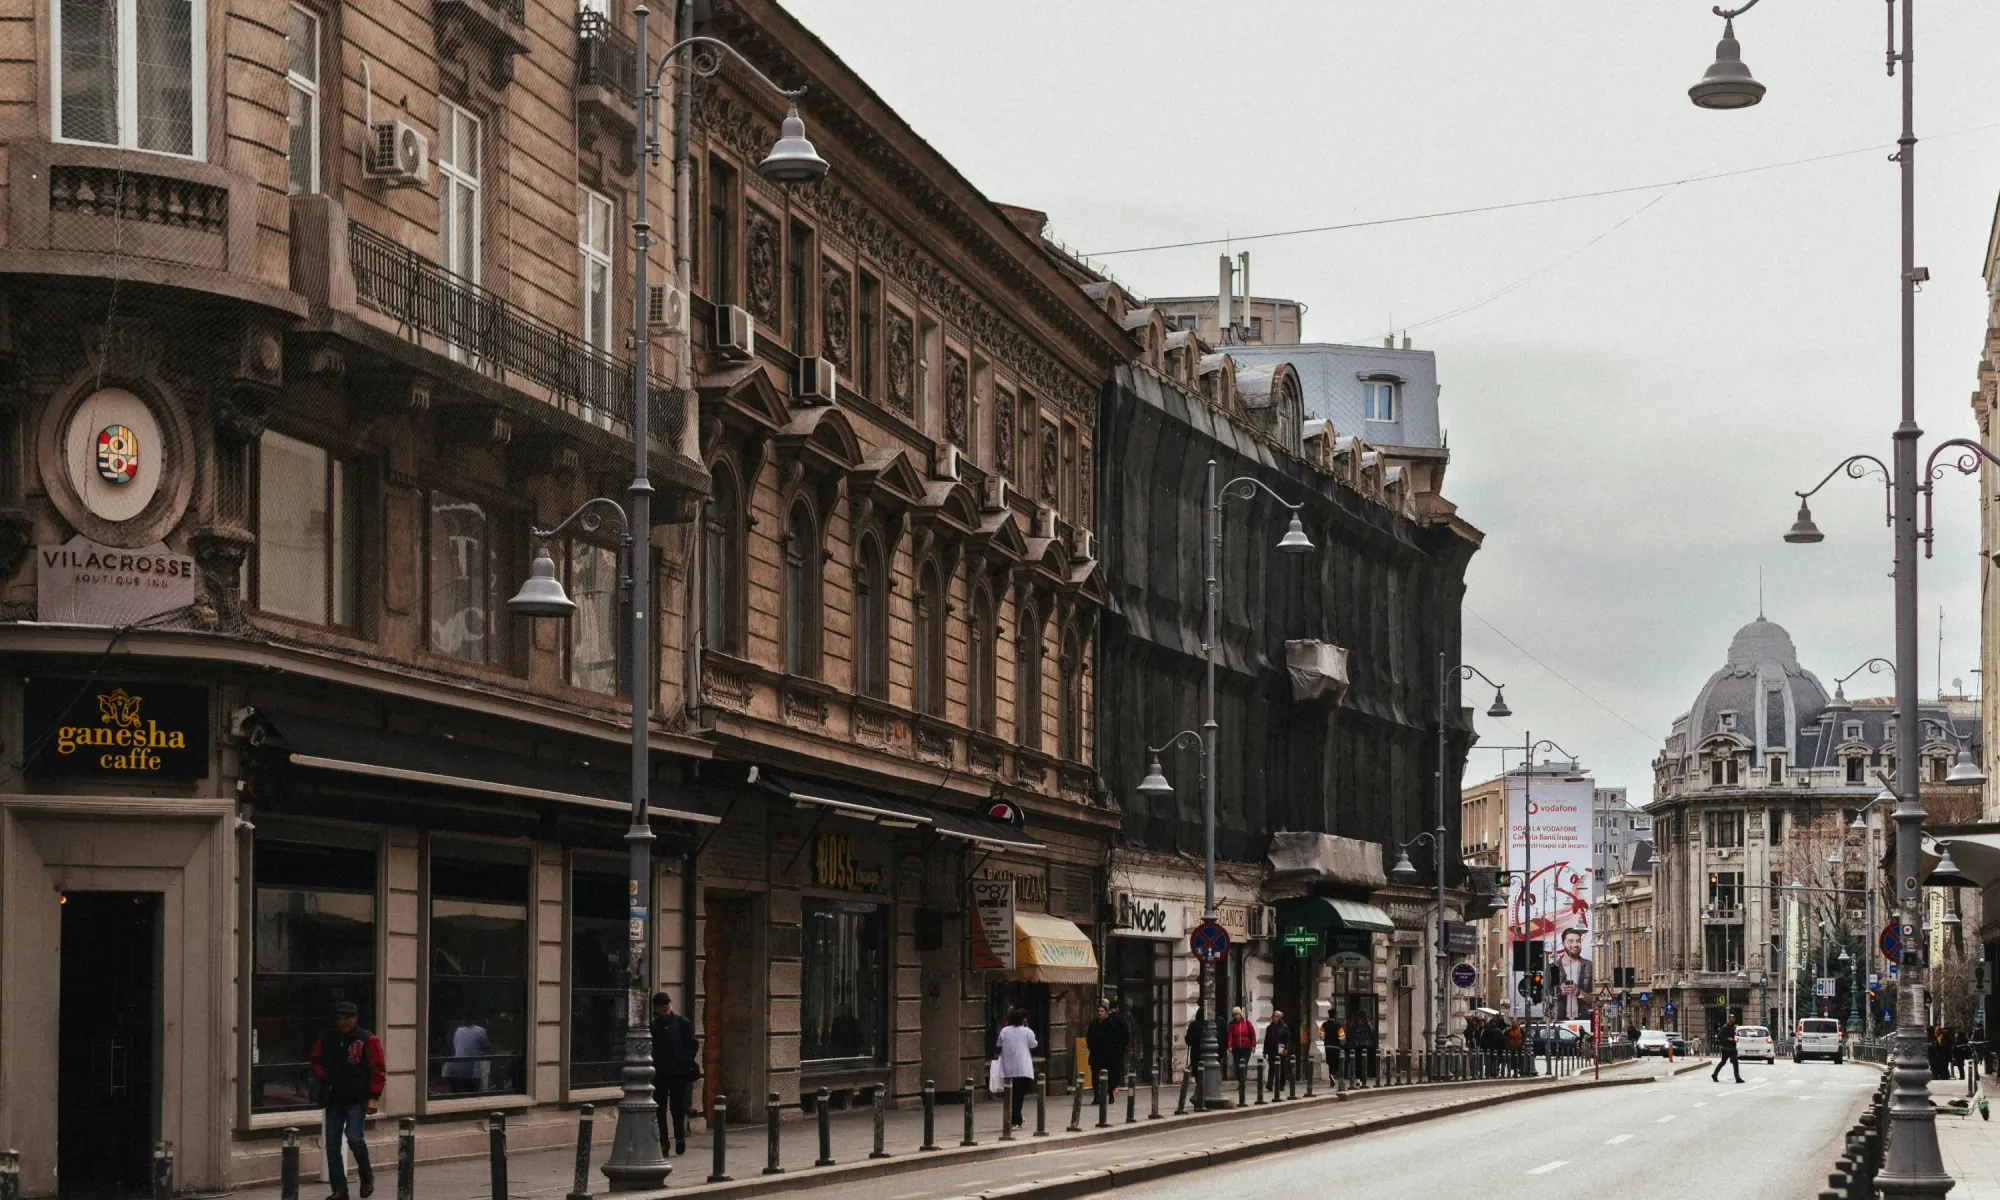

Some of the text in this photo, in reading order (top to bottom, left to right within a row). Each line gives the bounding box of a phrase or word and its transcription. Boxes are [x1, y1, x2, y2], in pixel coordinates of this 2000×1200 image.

[43, 551, 191, 578] VILACROSSE
[58, 719, 186, 754] ganesha
[100, 747, 162, 770] caffe
[1540, 804, 1578, 812] vodafone
[1539, 833, 1556, 841] Banii
[816, 833, 855, 889] BOSS
[1131, 899, 1167, 932] Noelle
